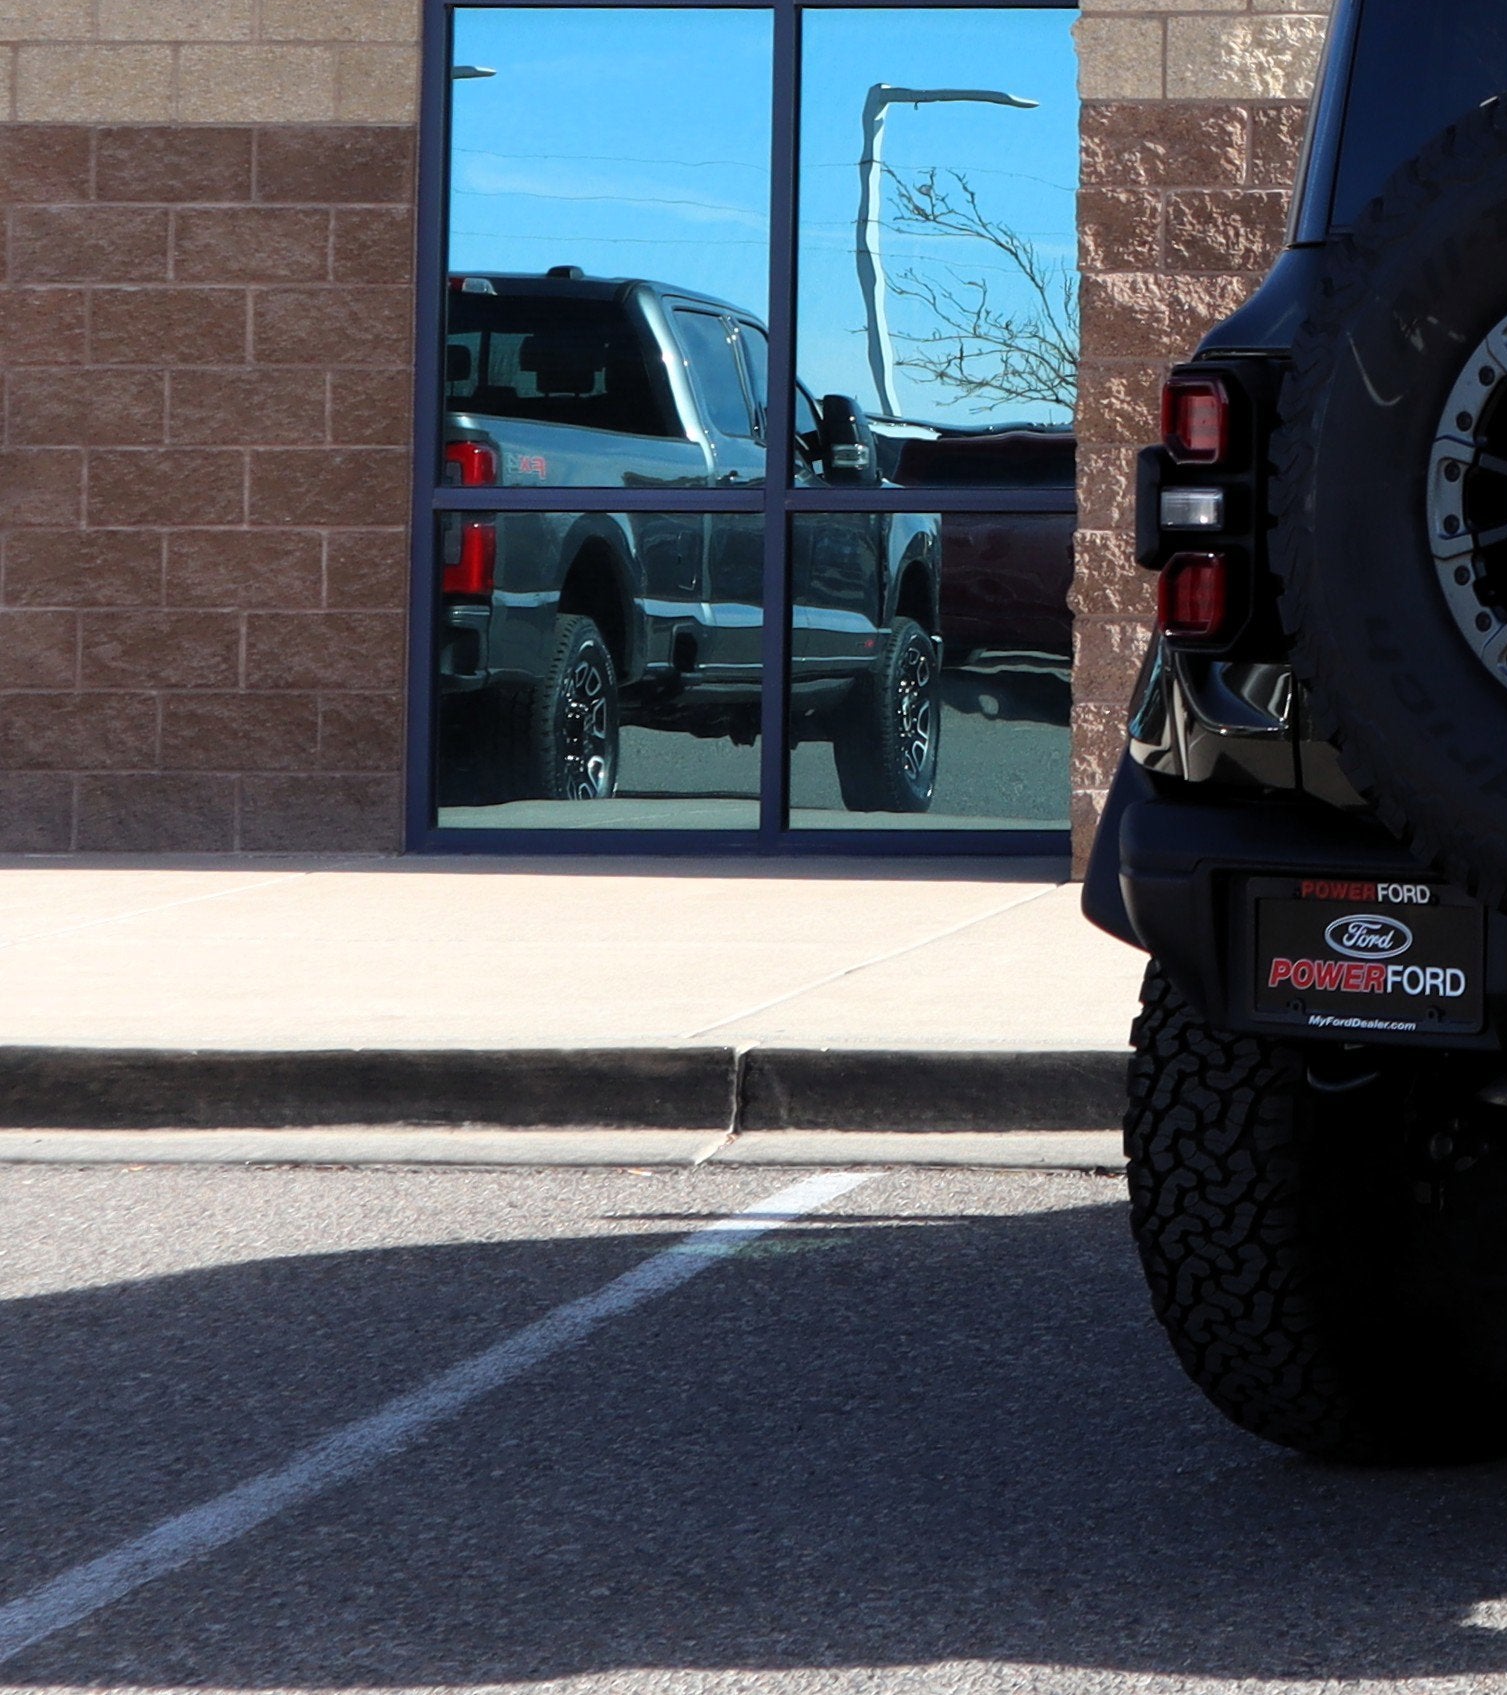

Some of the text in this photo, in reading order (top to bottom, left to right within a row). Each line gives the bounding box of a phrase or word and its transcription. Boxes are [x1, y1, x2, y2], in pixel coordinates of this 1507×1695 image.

[1301, 880, 1431, 904] POWERFORD
[1343, 921, 1394, 950] Ford
[1268, 957, 1466, 997] POWERFORD
[1308, 1014, 1416, 1032] MyFordDealer.com
